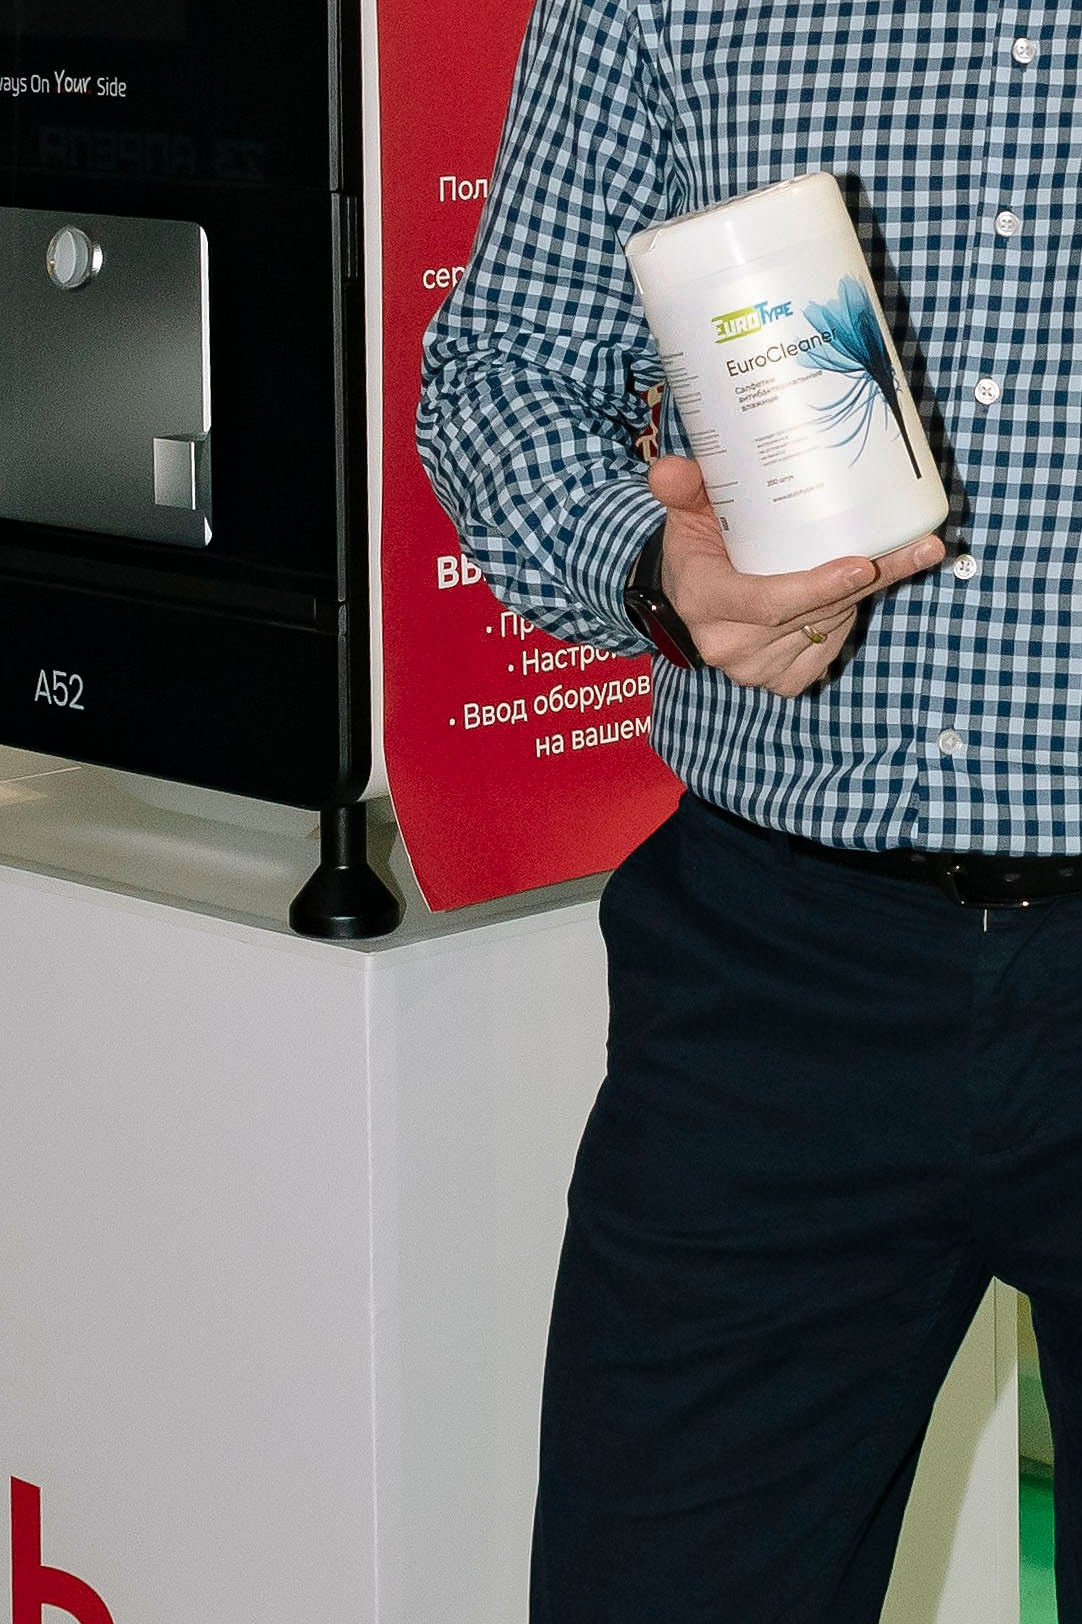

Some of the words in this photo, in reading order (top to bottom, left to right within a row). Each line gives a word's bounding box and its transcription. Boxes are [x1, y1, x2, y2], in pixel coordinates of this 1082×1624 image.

[31, 74, 50, 94] On
[54, 69, 91, 94] Your
[97, 76, 127, 97] Side
[726, 327, 837, 377] EuroCleaner
[34, 669, 85, 711] A52
[463, 699, 528, 730] Ввод
[533, 675, 651, 713] оборудов
[536, 734, 564, 758] на
[571, 716, 651, 751] вашем
